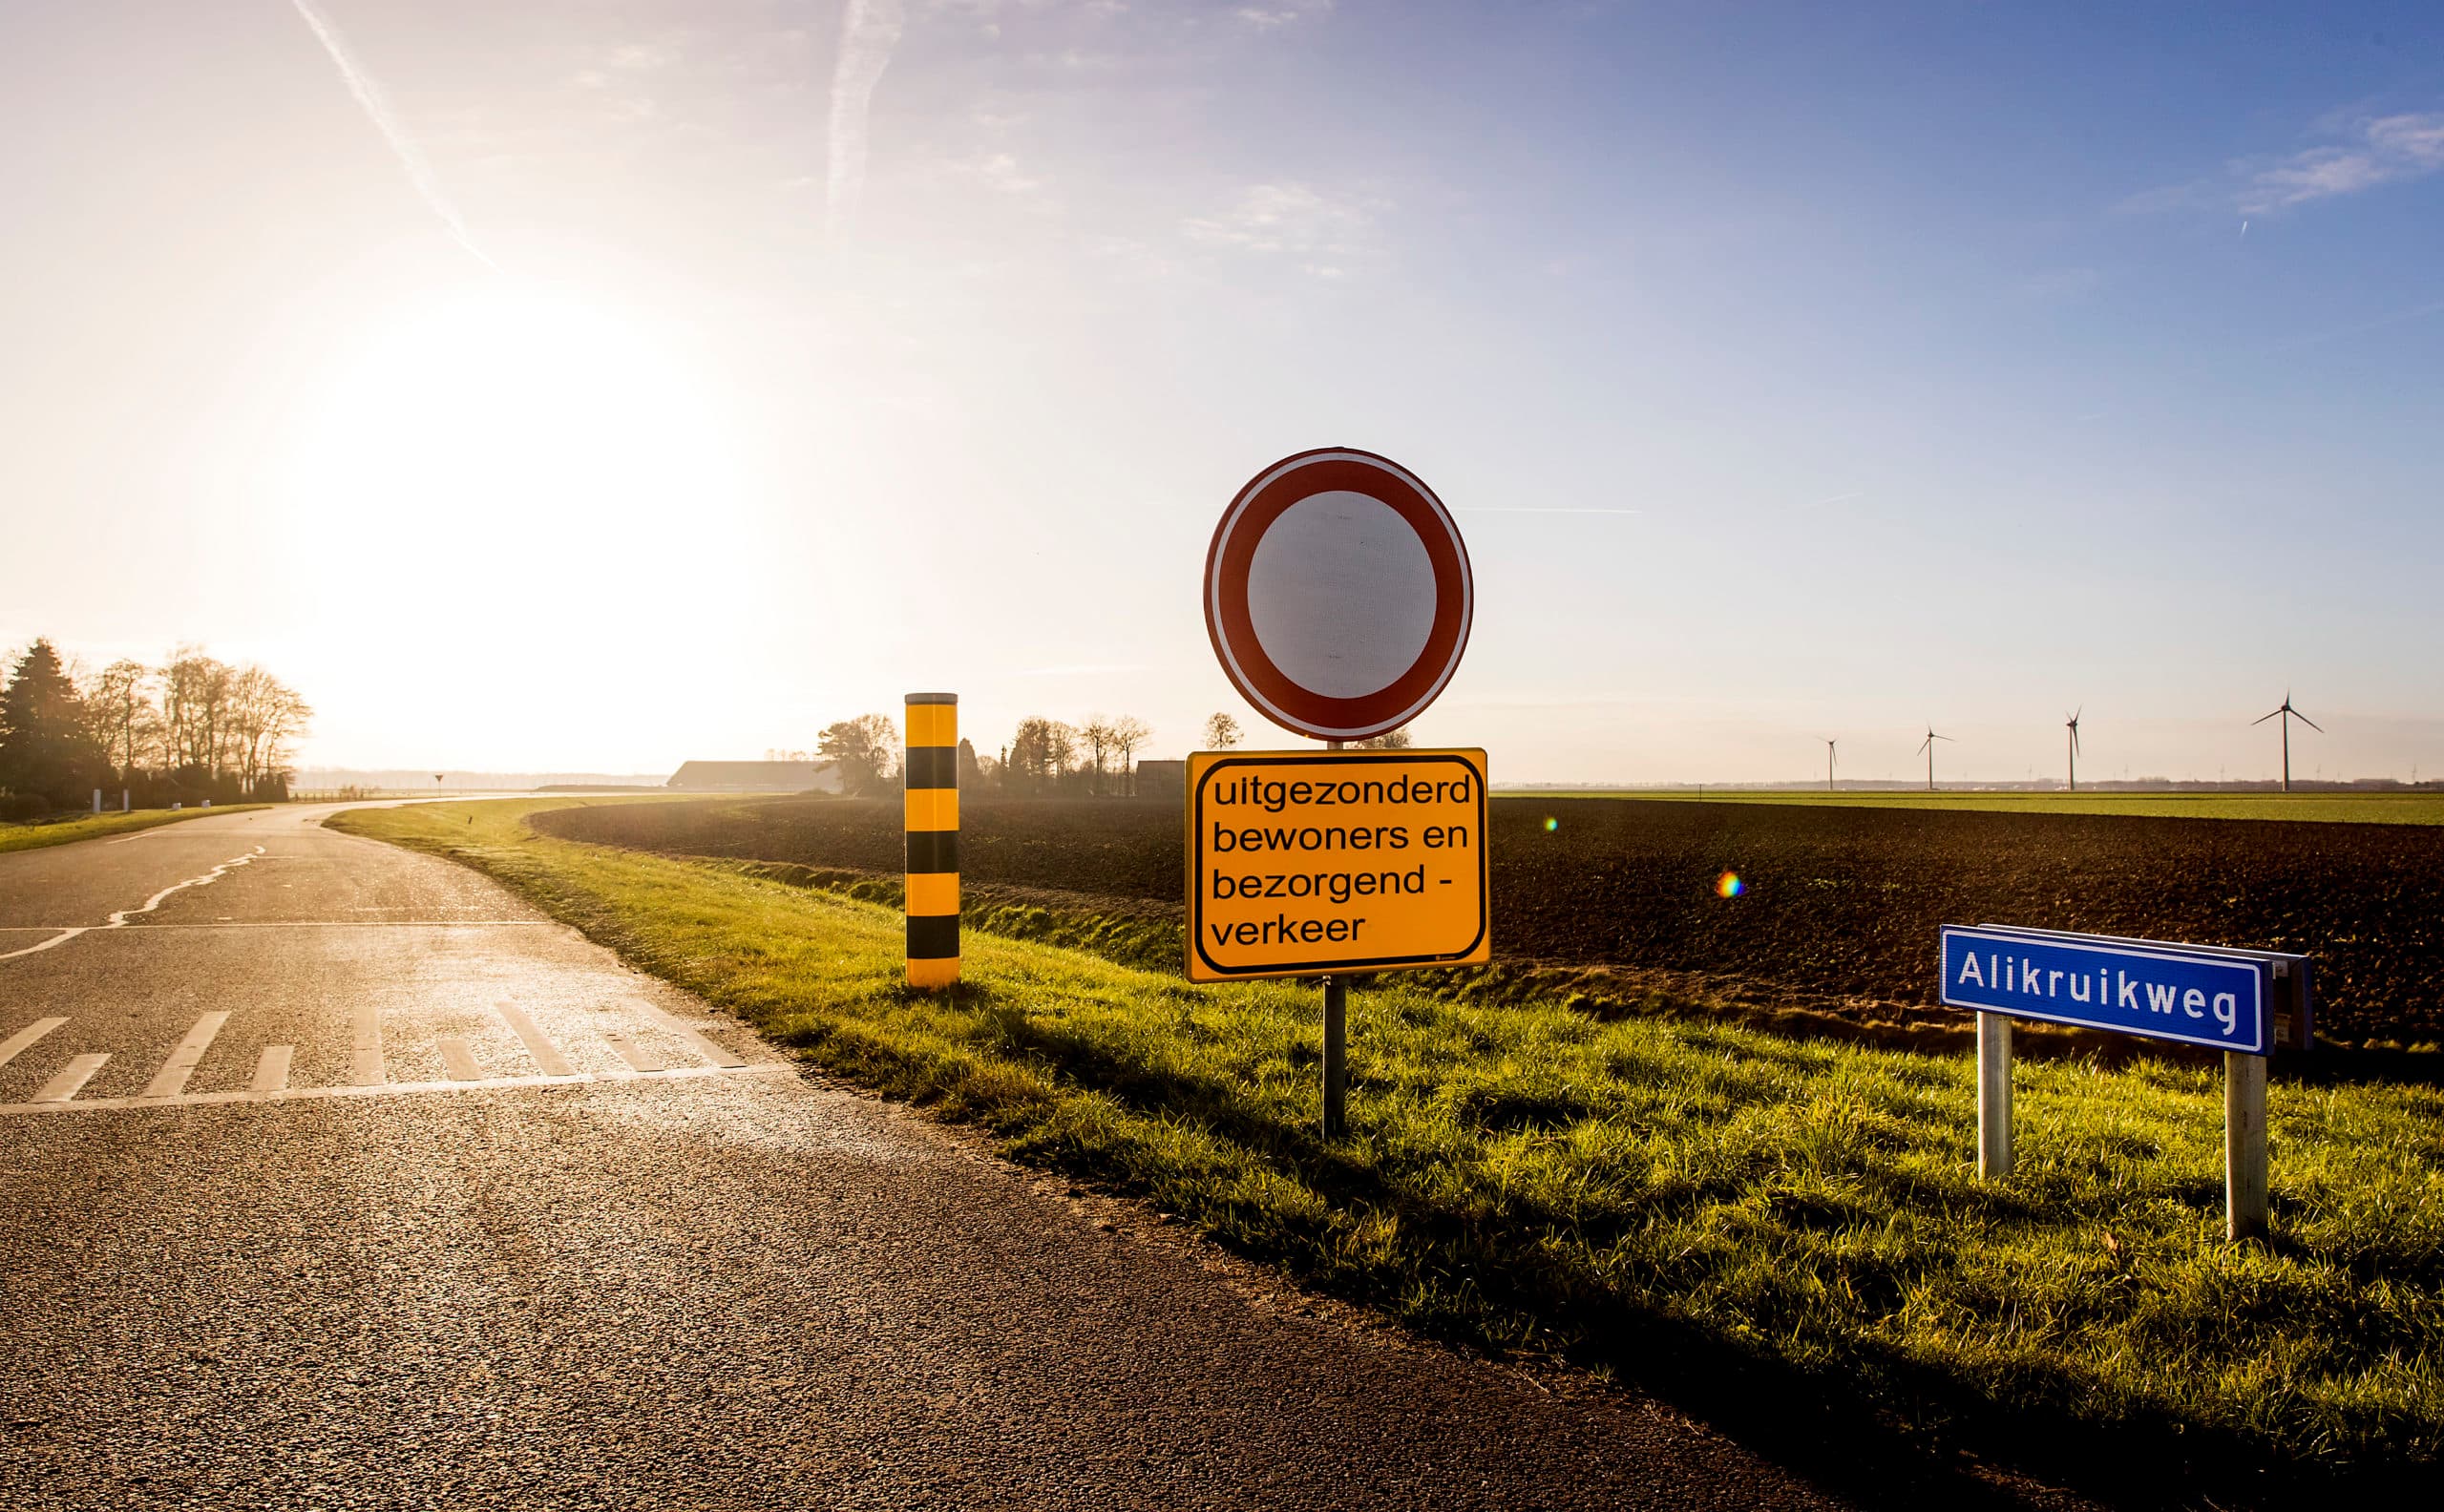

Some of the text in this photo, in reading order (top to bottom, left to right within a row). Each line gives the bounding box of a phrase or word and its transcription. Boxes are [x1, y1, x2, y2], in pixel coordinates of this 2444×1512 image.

[1214, 774, 1470, 812] uitgezonderd
[1213, 821, 1468, 852] bewoners en
[1213, 864, 1424, 903] bezorgend
[1211, 914, 1366, 946] verkeer
[1958, 951, 2237, 1037] Alikruikweg
